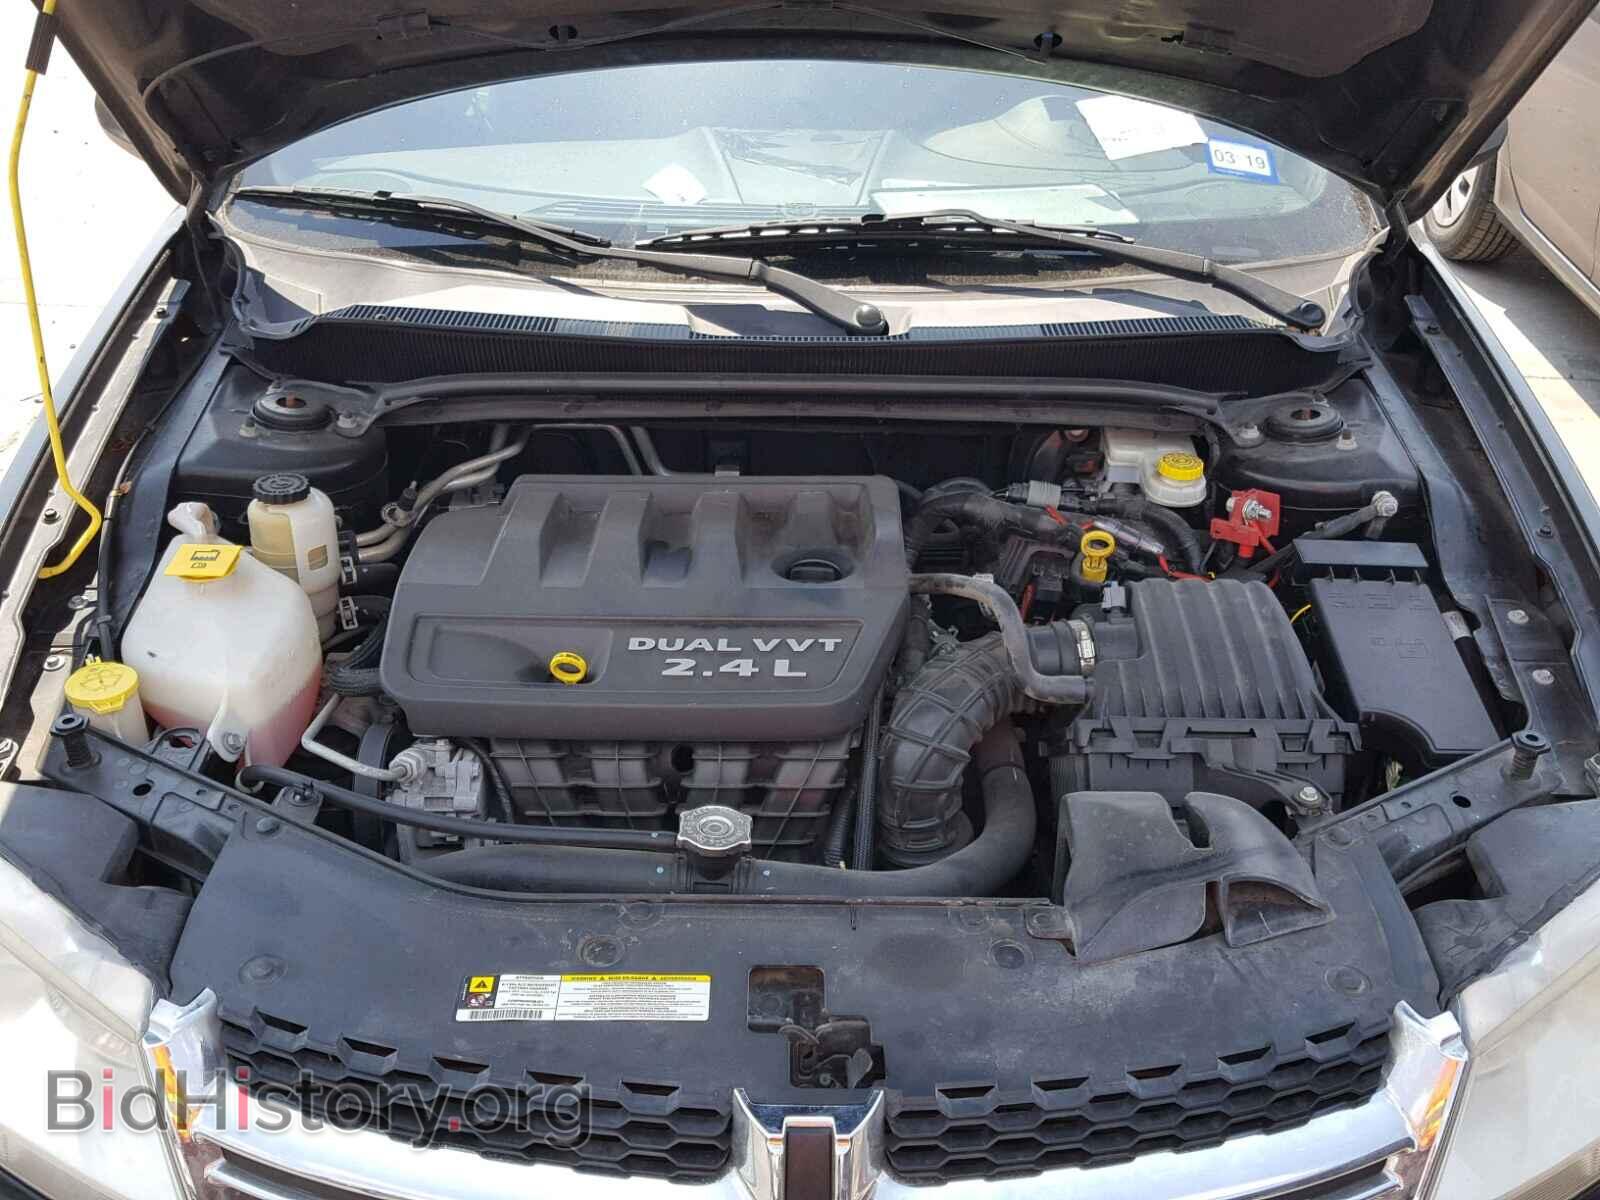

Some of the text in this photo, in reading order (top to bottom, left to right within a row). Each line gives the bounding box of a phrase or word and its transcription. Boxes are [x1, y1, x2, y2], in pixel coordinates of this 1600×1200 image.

[1214, 149, 1266, 169] 03 19
[628, 637, 842, 652] DUAL VVT
[661, 658, 807, 677] 2.4 L
